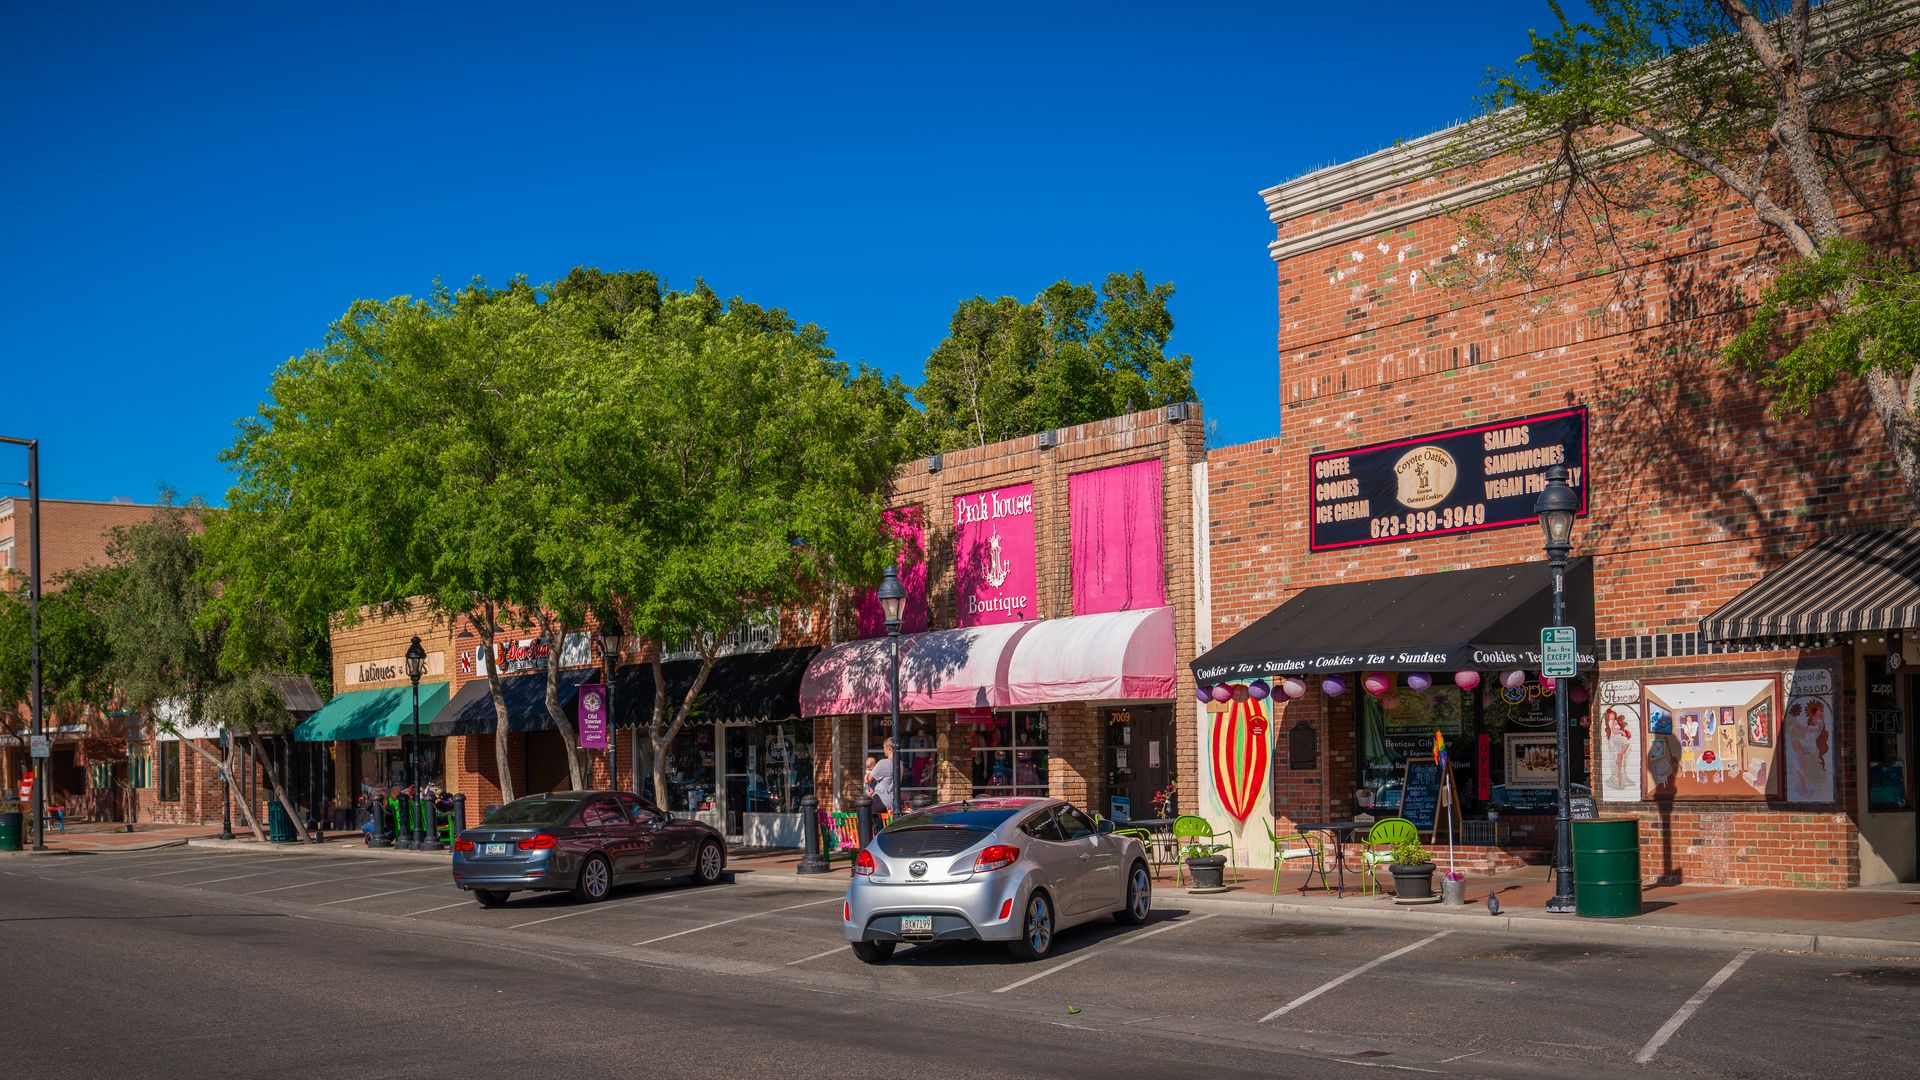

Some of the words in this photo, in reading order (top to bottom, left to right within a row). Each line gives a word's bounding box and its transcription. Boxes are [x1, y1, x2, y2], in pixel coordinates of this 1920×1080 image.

[1484, 426, 1530, 451] SALADS
[1316, 456, 1350, 479] COFFEE
[1397, 454, 1422, 474] Coyote
[1424, 451, 1448, 467] Oaties
[1484, 445, 1565, 475] SANDWICHES
[1316, 478, 1359, 501] COOKIES
[1485, 476, 1523, 500] VEGAN
[1525, 467, 1581, 496] FRILY
[956, 494, 989, 525] Pink
[991, 491, 1033, 520] house
[1426, 493, 1443, 501] Cookies
[1316, 503, 1334, 524] ICE
[1334, 500, 1370, 522] CREAM
[1370, 504, 1485, 539] 623-939-3949
[968, 592, 1027, 616] Boutique
[1546, 632, 1552, 641] 2
[506, 640, 526, 661] Don
[1473, 650, 1517, 664] Cookies
[359, 662, 396, 682] Antiques
[1197, 665, 1228, 680] Cookies
[1236, 663, 1254, 673] Tea
[1263, 660, 1305, 672] Sundaes
[1316, 655, 1355, 668] Cookies
[1366, 654, 1385, 665] Tea
[1397, 651, 1447, 664] Sundaes
[1111, 712, 1130, 723] 7009
[1385, 739, 1415, 748] Boutique
